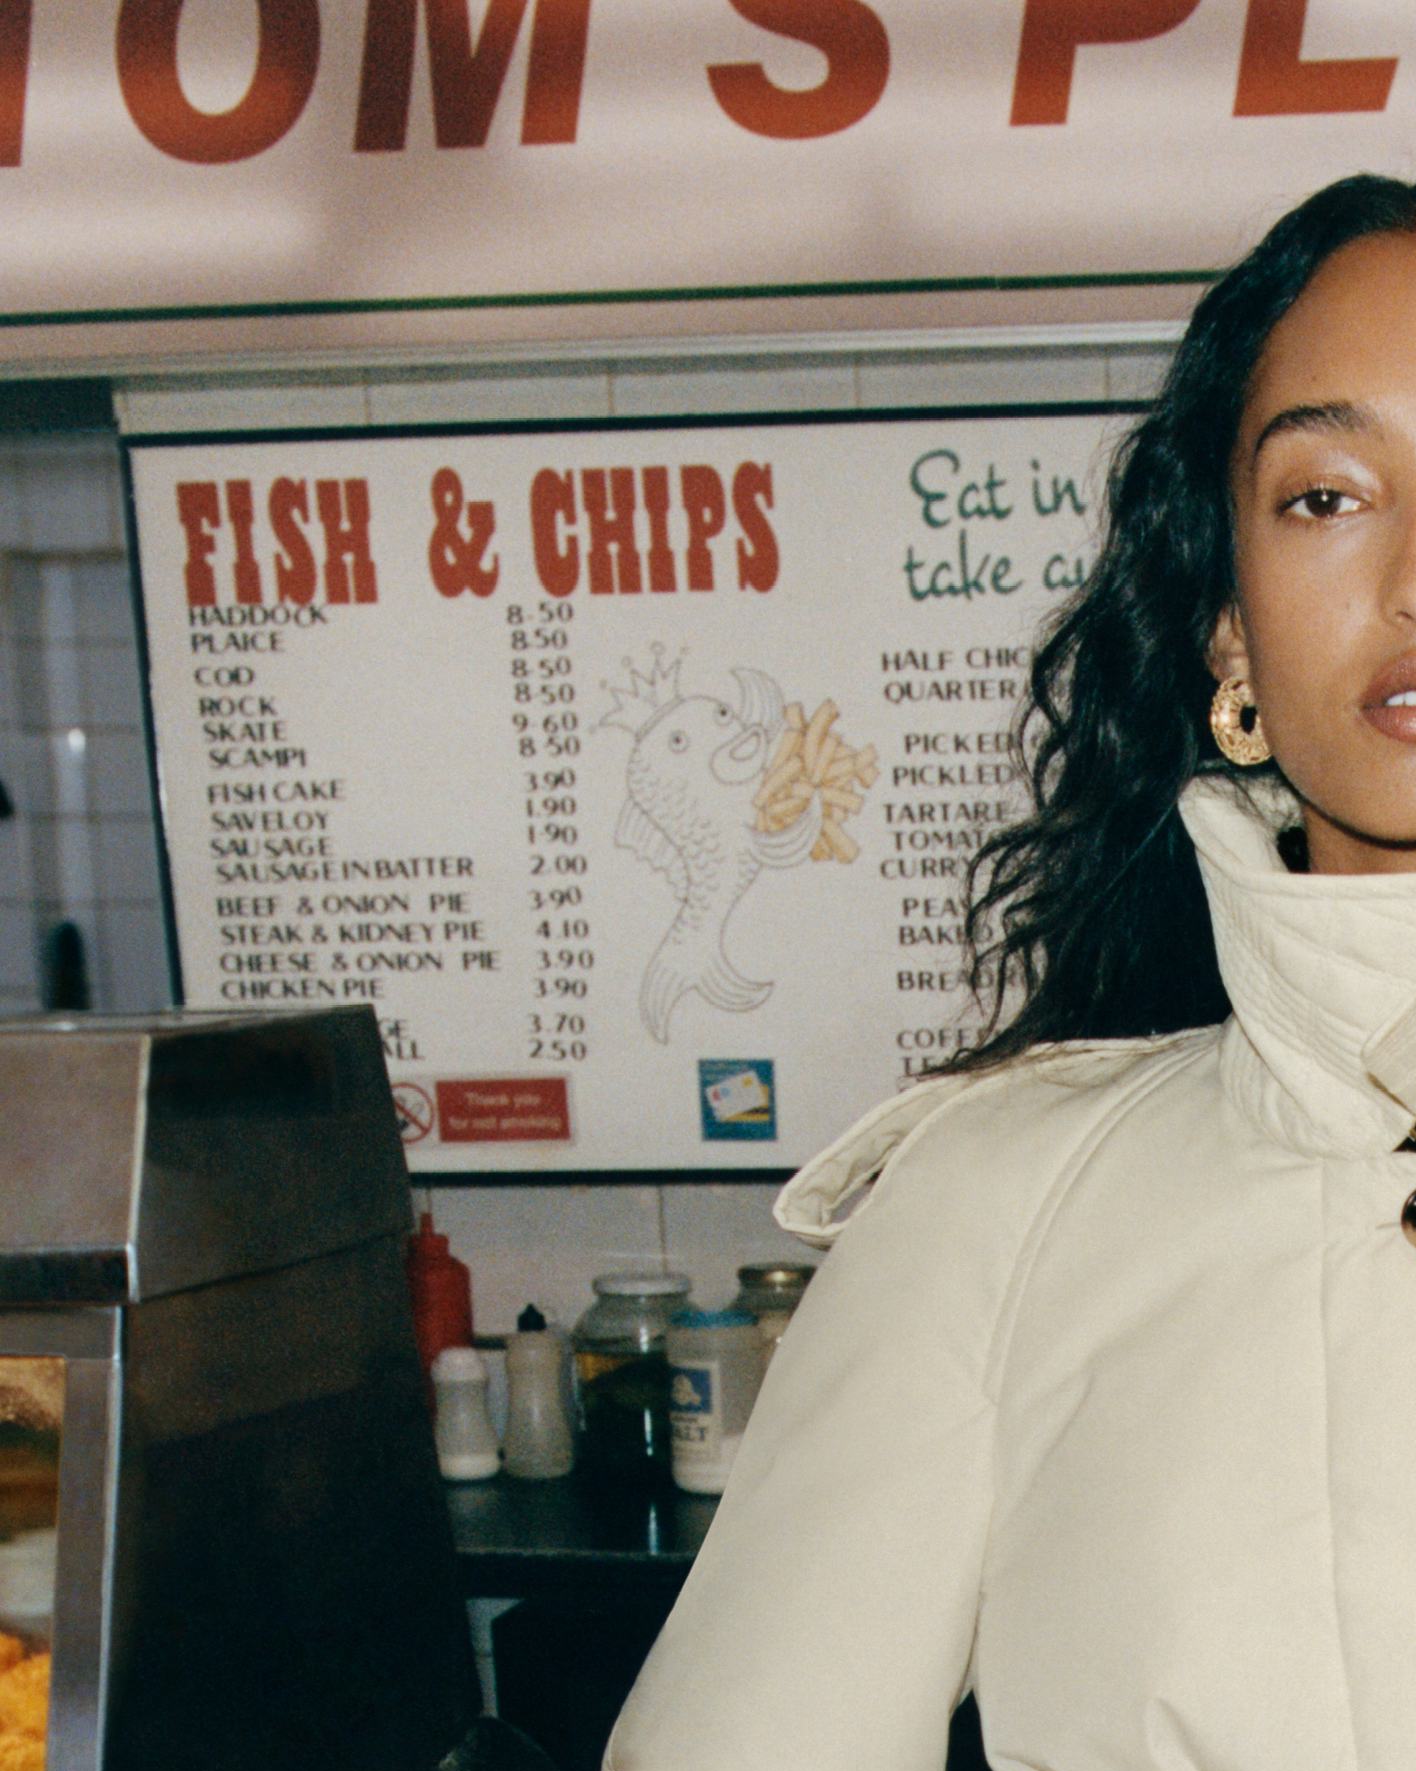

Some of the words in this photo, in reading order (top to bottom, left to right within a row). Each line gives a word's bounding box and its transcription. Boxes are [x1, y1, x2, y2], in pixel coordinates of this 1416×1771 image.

[910, 448, 1013, 528] Eat
[1031, 459, 1086, 516] in
[176, 477, 378, 606] FISH
[428, 466, 500, 598] &
[530, 461, 779, 597] CHIPS
[904, 528, 1024, 601] take
[189, 605, 328, 627] HADDOCK
[191, 631, 285, 653] PLAICE
[881, 650, 952, 672] HALF
[194, 667, 255, 688] COD
[883, 680, 1016, 704] QUARTER
[199, 696, 277, 717] ROCK
[203, 720, 286, 742] SKATE
[904, 732, 1016, 754] PICKED
[208, 747, 307, 769] SCAMPI
[893, 764, 1016, 787] PICKLED
[208, 782, 266, 804] FISH
[272, 779, 347, 802] CAKE
[211, 811, 329, 832] SAVELOY
[210, 836, 332, 858] SAUSAGE
[893, 829, 986, 851] TOMAT
[216, 861, 333, 883] SAUSAGE
[342, 860, 370, 881] IN
[375, 857, 474, 880] BATTER
[216, 896, 277, 918] BEEF
[297, 896, 314, 916] &
[322, 893, 409, 915] ONION
[430, 893, 470, 914] PIE
[220, 924, 304, 946] STEAK
[312, 924, 328, 944] &
[339, 922, 435, 944] KIDNEY
[444, 921, 485, 942] PIE
[220, 953, 317, 974] CHEESE
[331, 952, 349, 973] &
[356, 951, 444, 972] ONION
[462, 951, 501, 971] PIE
[221, 980, 336, 1001] CHICKEN
[343, 978, 386, 999] PIE
[897, 1028, 983, 1051] COFF
